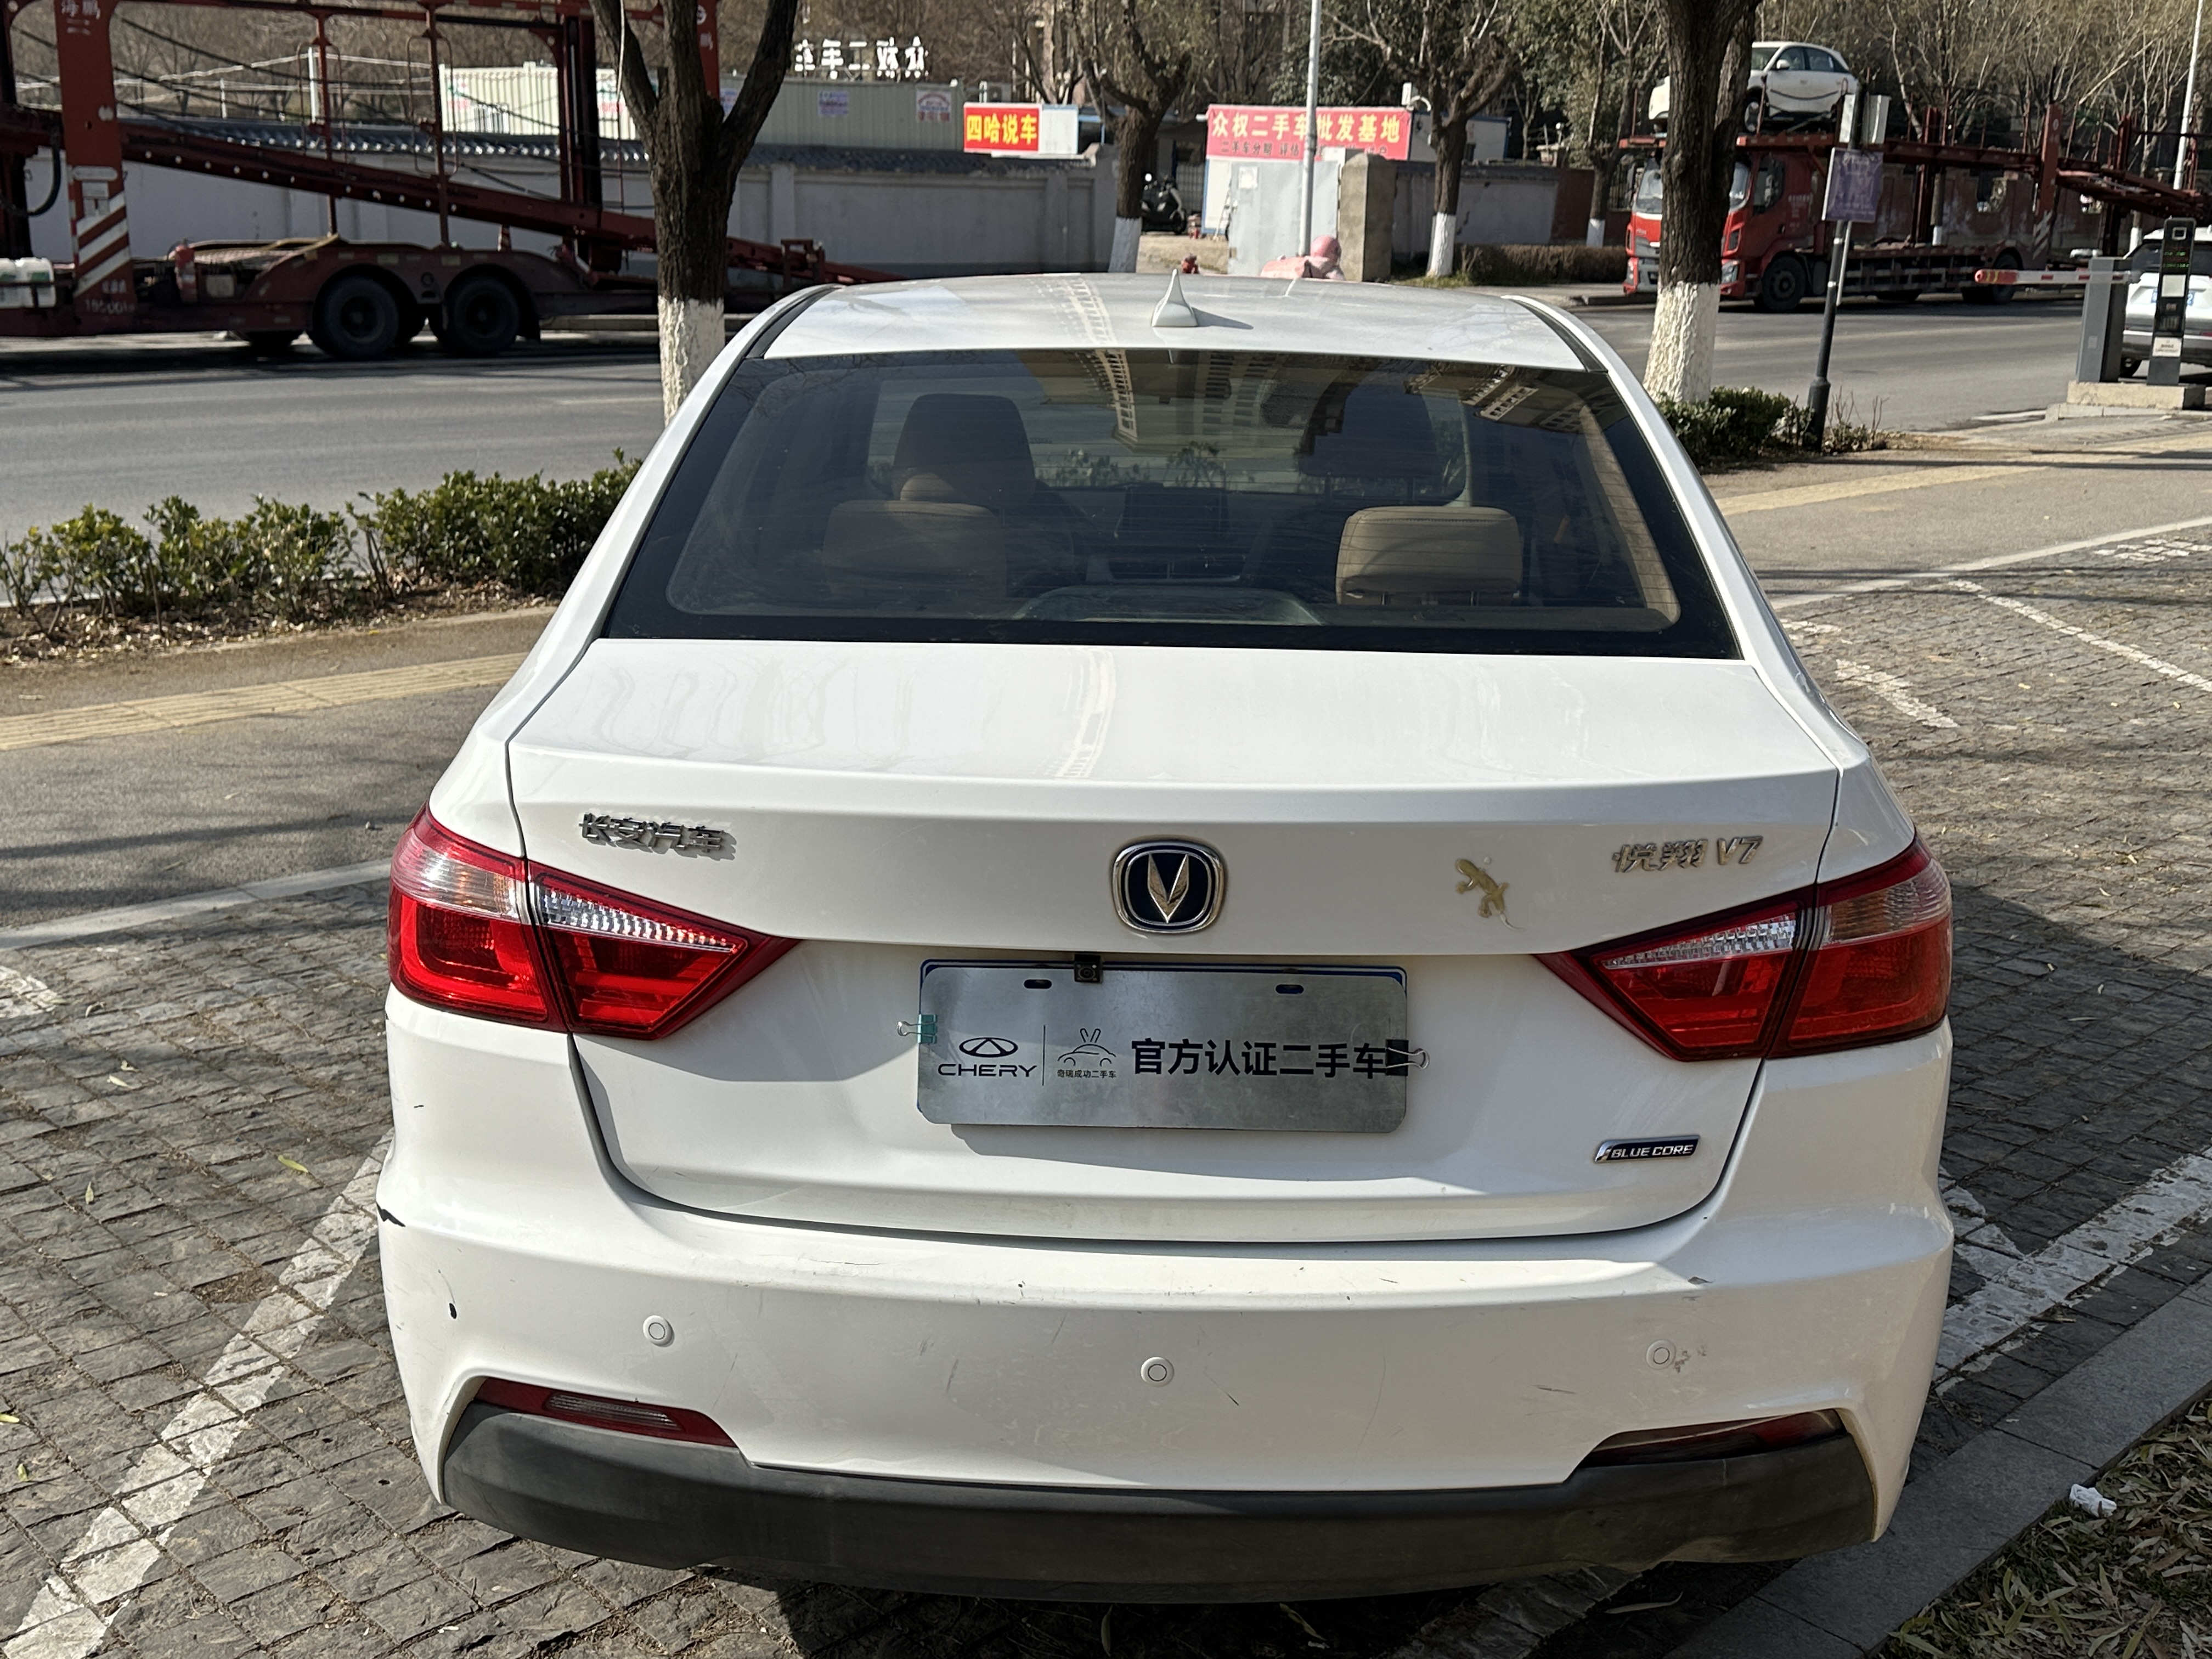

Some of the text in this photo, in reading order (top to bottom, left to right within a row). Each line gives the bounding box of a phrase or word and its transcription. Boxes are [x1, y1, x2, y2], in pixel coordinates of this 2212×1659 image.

[966, 113, 1037, 145] 四哈说车
[1211, 111, 1401, 144] 众权二手车批发基地
[579, 812, 724, 854] 长安汽车
[1611, 836, 1764, 873] 悦翔 V7
[937, 1063, 1037, 1077] CHERY
[1057, 1069, 1117, 1079] 奇瑞成功二手车
[1131, 1037, 1388, 1080] 官方认证二手车
[1611, 1144, 1694, 1159] BLUE CORE
